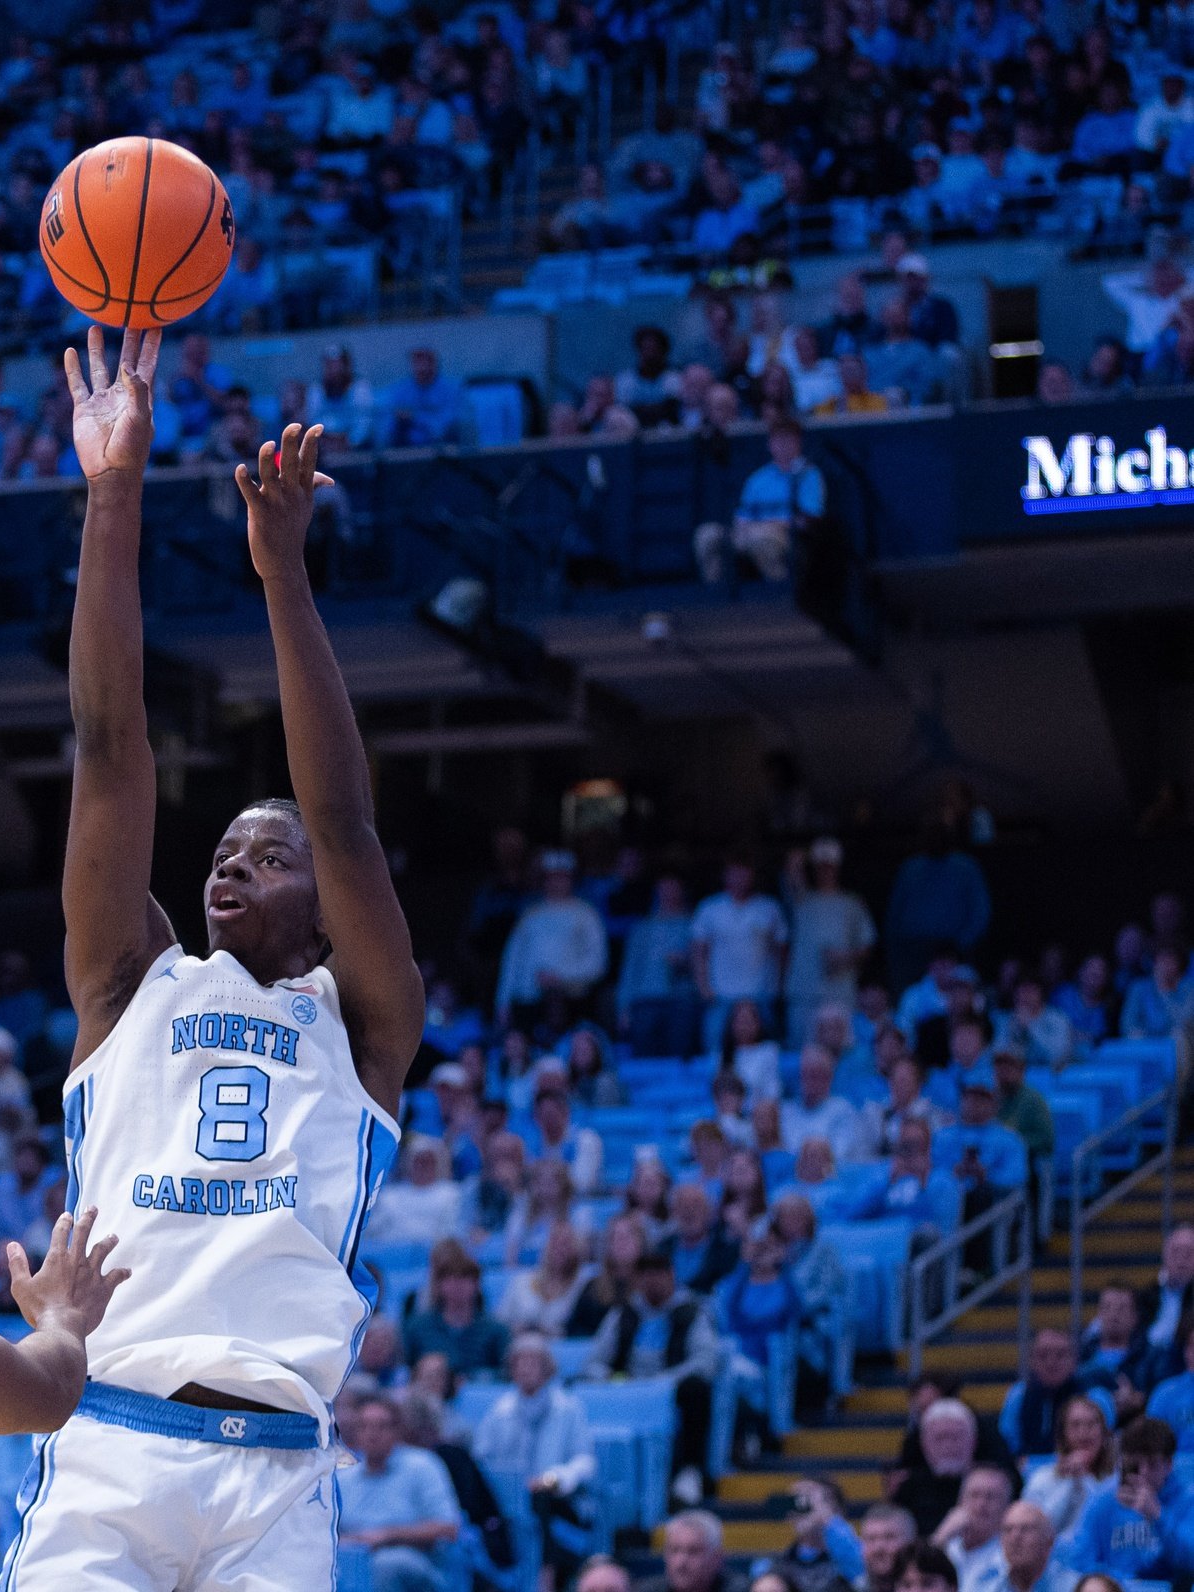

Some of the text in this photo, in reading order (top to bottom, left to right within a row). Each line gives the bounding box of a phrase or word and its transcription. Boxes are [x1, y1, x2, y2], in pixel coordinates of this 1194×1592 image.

[1020, 427, 1194, 500] Mich
[172, 1013, 300, 1066] NORTH
[195, 1066, 270, 1162] 8
